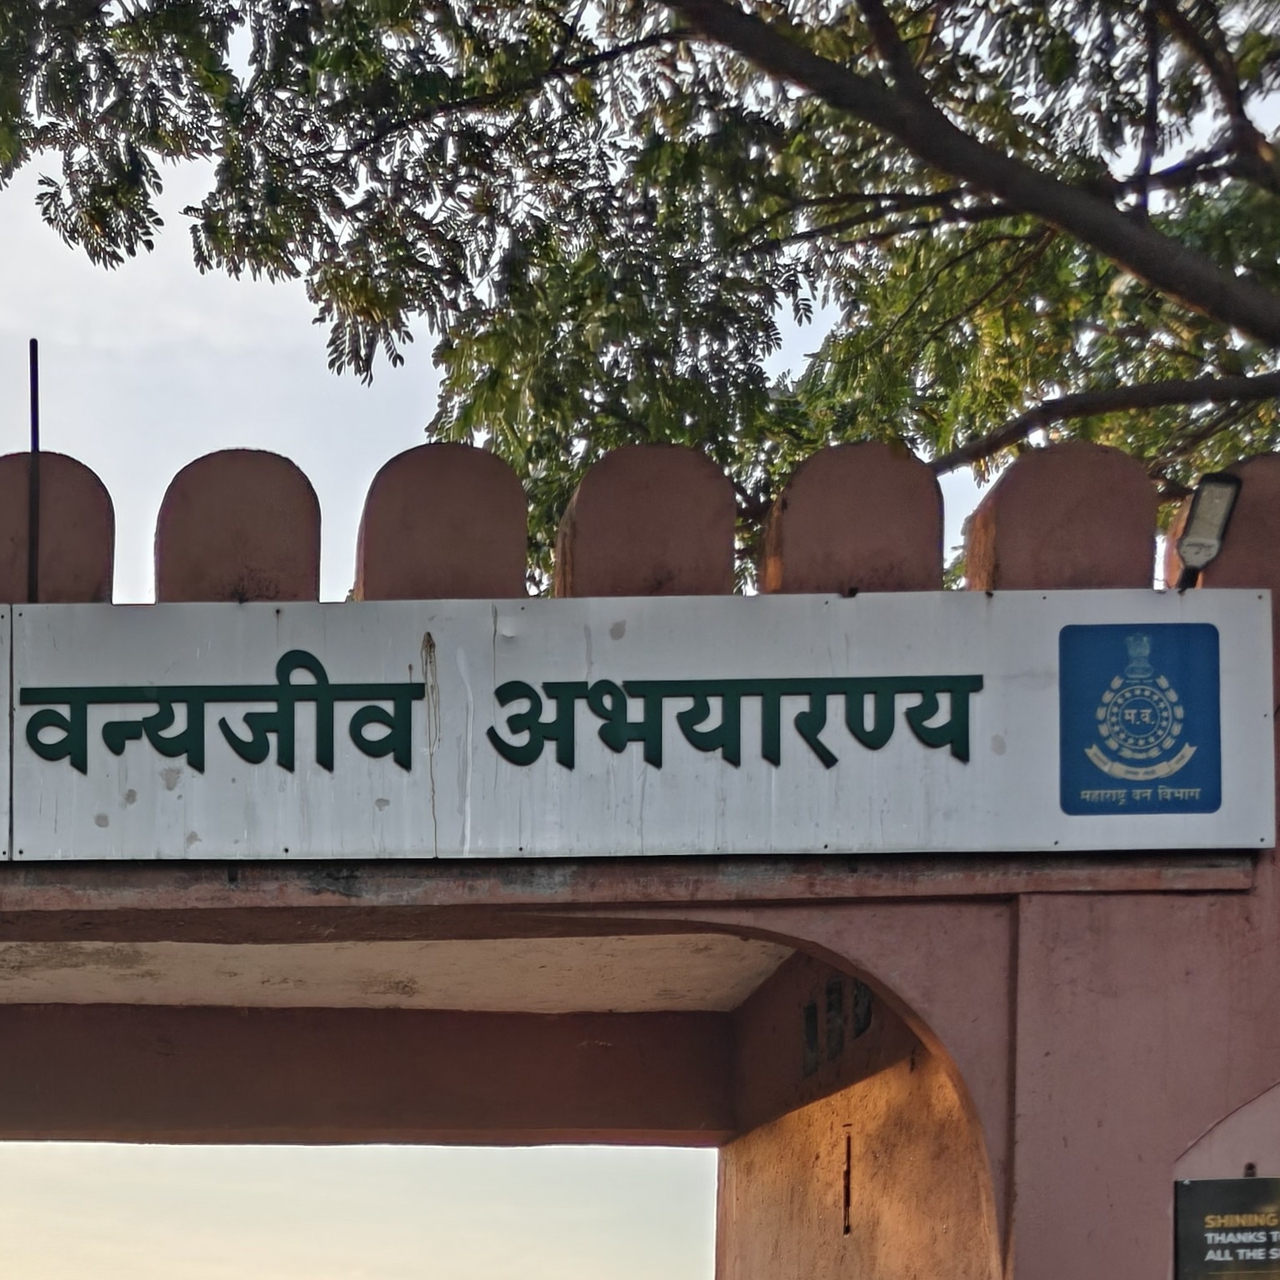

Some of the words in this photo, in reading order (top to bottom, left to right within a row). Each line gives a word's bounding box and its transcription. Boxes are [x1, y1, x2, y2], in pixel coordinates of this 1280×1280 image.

[20, 650, 426, 774] वन्यजीव
[487, 674, 984, 769] अभयारण्य
[1131, 789, 1153, 801] वन
[1158, 785, 1202, 801] विभाग
[1204, 1213, 1278, 1228] SHINING
[1204, 1231, 1267, 1244] THANKS
[1204, 1249, 1234, 1261] ALL
[1236, 1248, 1266, 1260] THE
